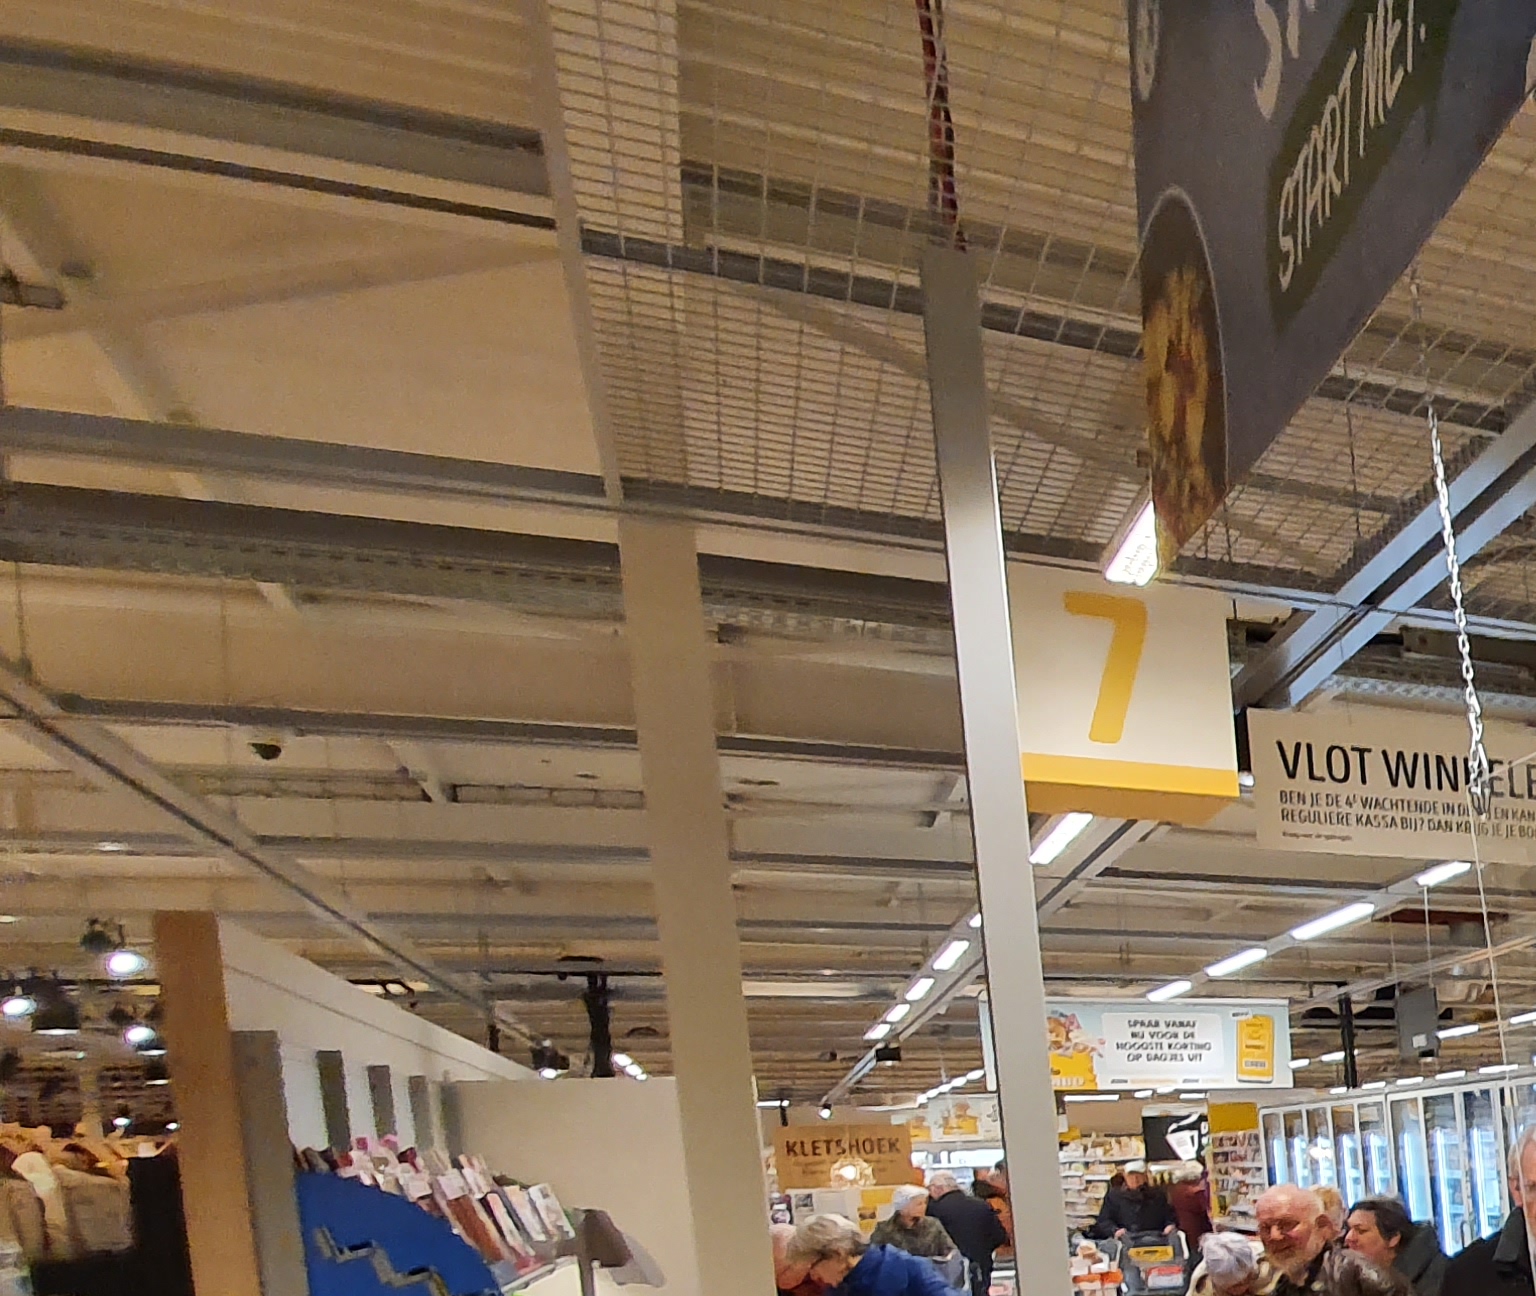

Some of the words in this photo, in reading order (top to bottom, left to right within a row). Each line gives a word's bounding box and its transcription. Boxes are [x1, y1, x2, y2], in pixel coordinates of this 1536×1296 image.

[1279, 49, 1357, 292] START
[1062, 590, 1149, 744] 7
[1276, 740, 1373, 785] VLOT
[1281, 808, 1352, 826] REGULIERE
[1356, 813, 1398, 829] KASSA
[1456, 821, 1489, 836] KRJG
[786, 1138, 900, 1157] KLETSHOEK
